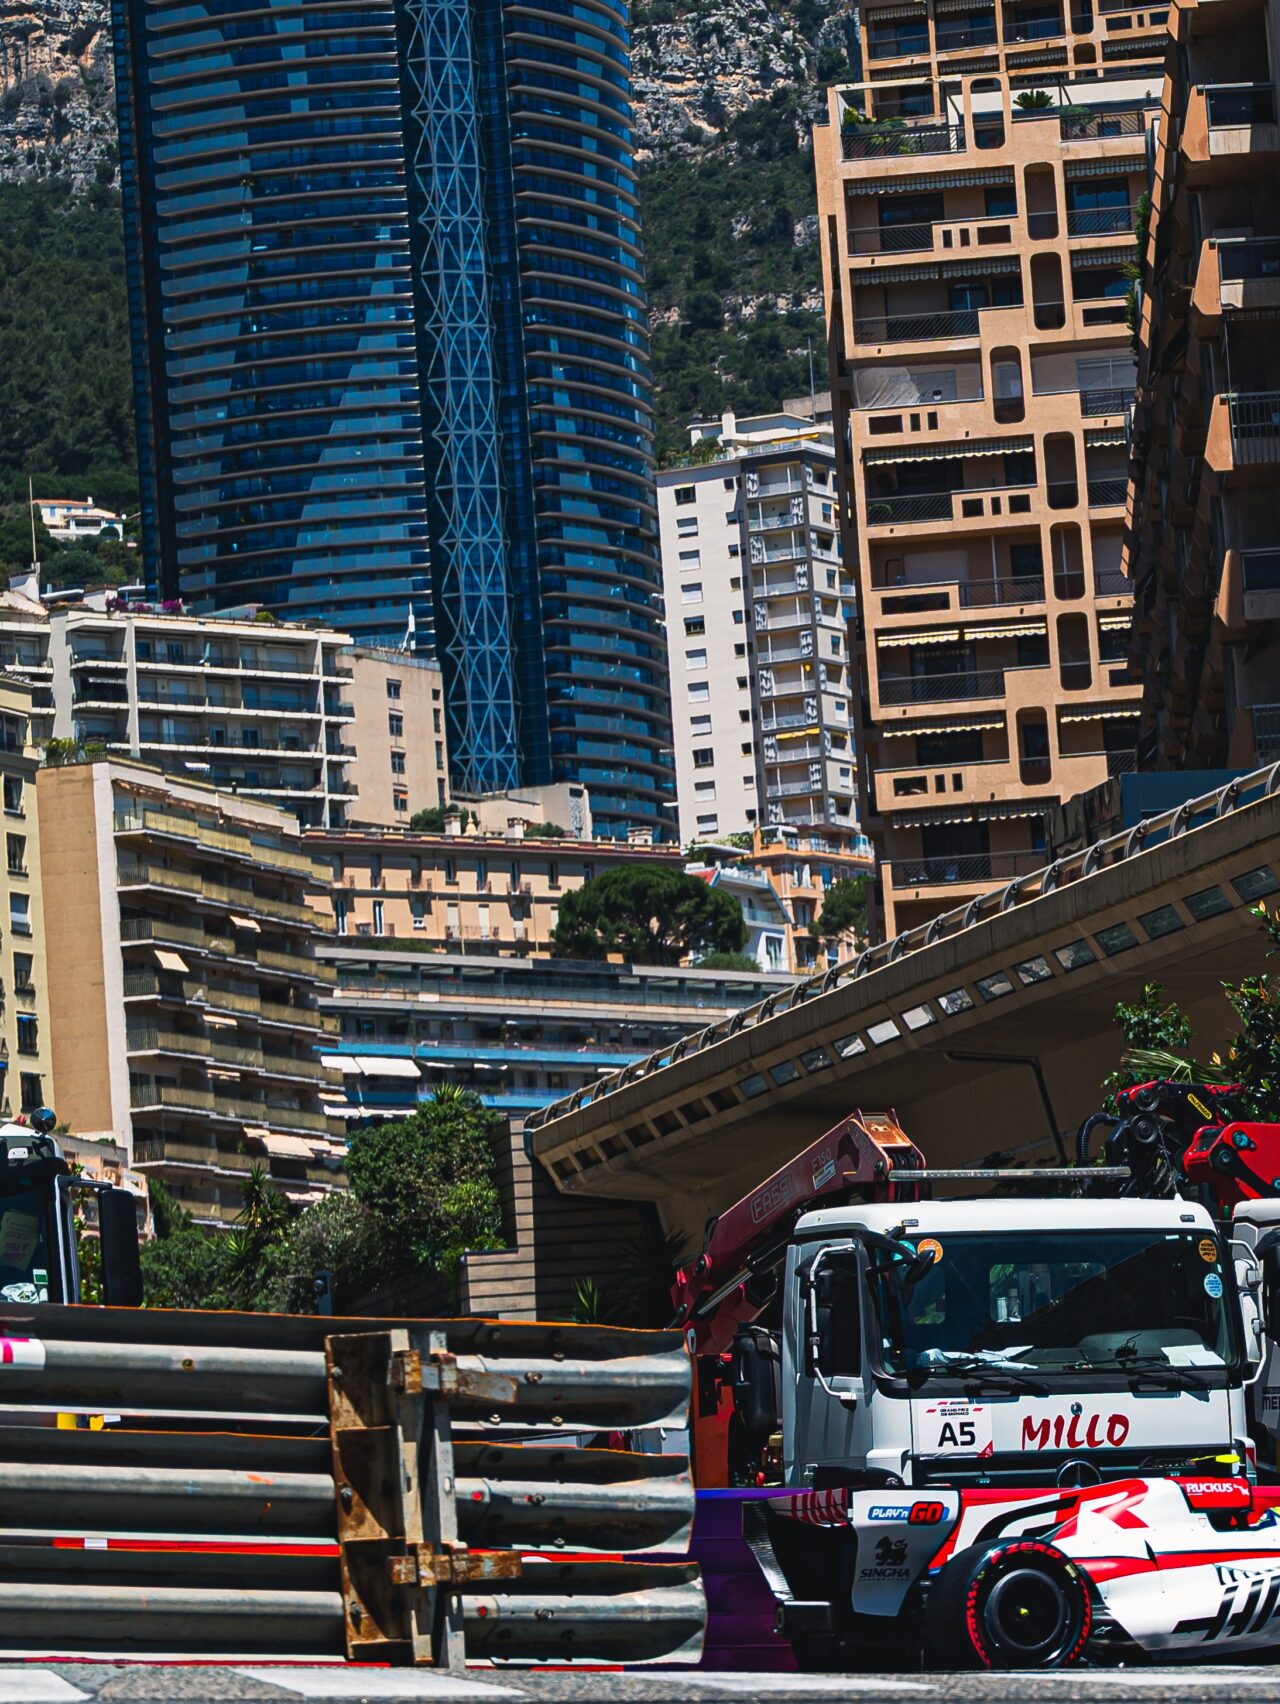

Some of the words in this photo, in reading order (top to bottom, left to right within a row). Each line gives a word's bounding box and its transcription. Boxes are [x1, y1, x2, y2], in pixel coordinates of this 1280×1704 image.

[754, 1174, 794, 1219] FASSI
[937, 1422, 976, 1447] A5
[1021, 1414, 1130, 1451] MILLO
[1185, 1483, 1233, 1493] RUCKUS
[910, 1503, 943, 1522] GO
[1006, 1541, 1062, 1559] ZERO
[860, 1567, 910, 1578] SINGHA
